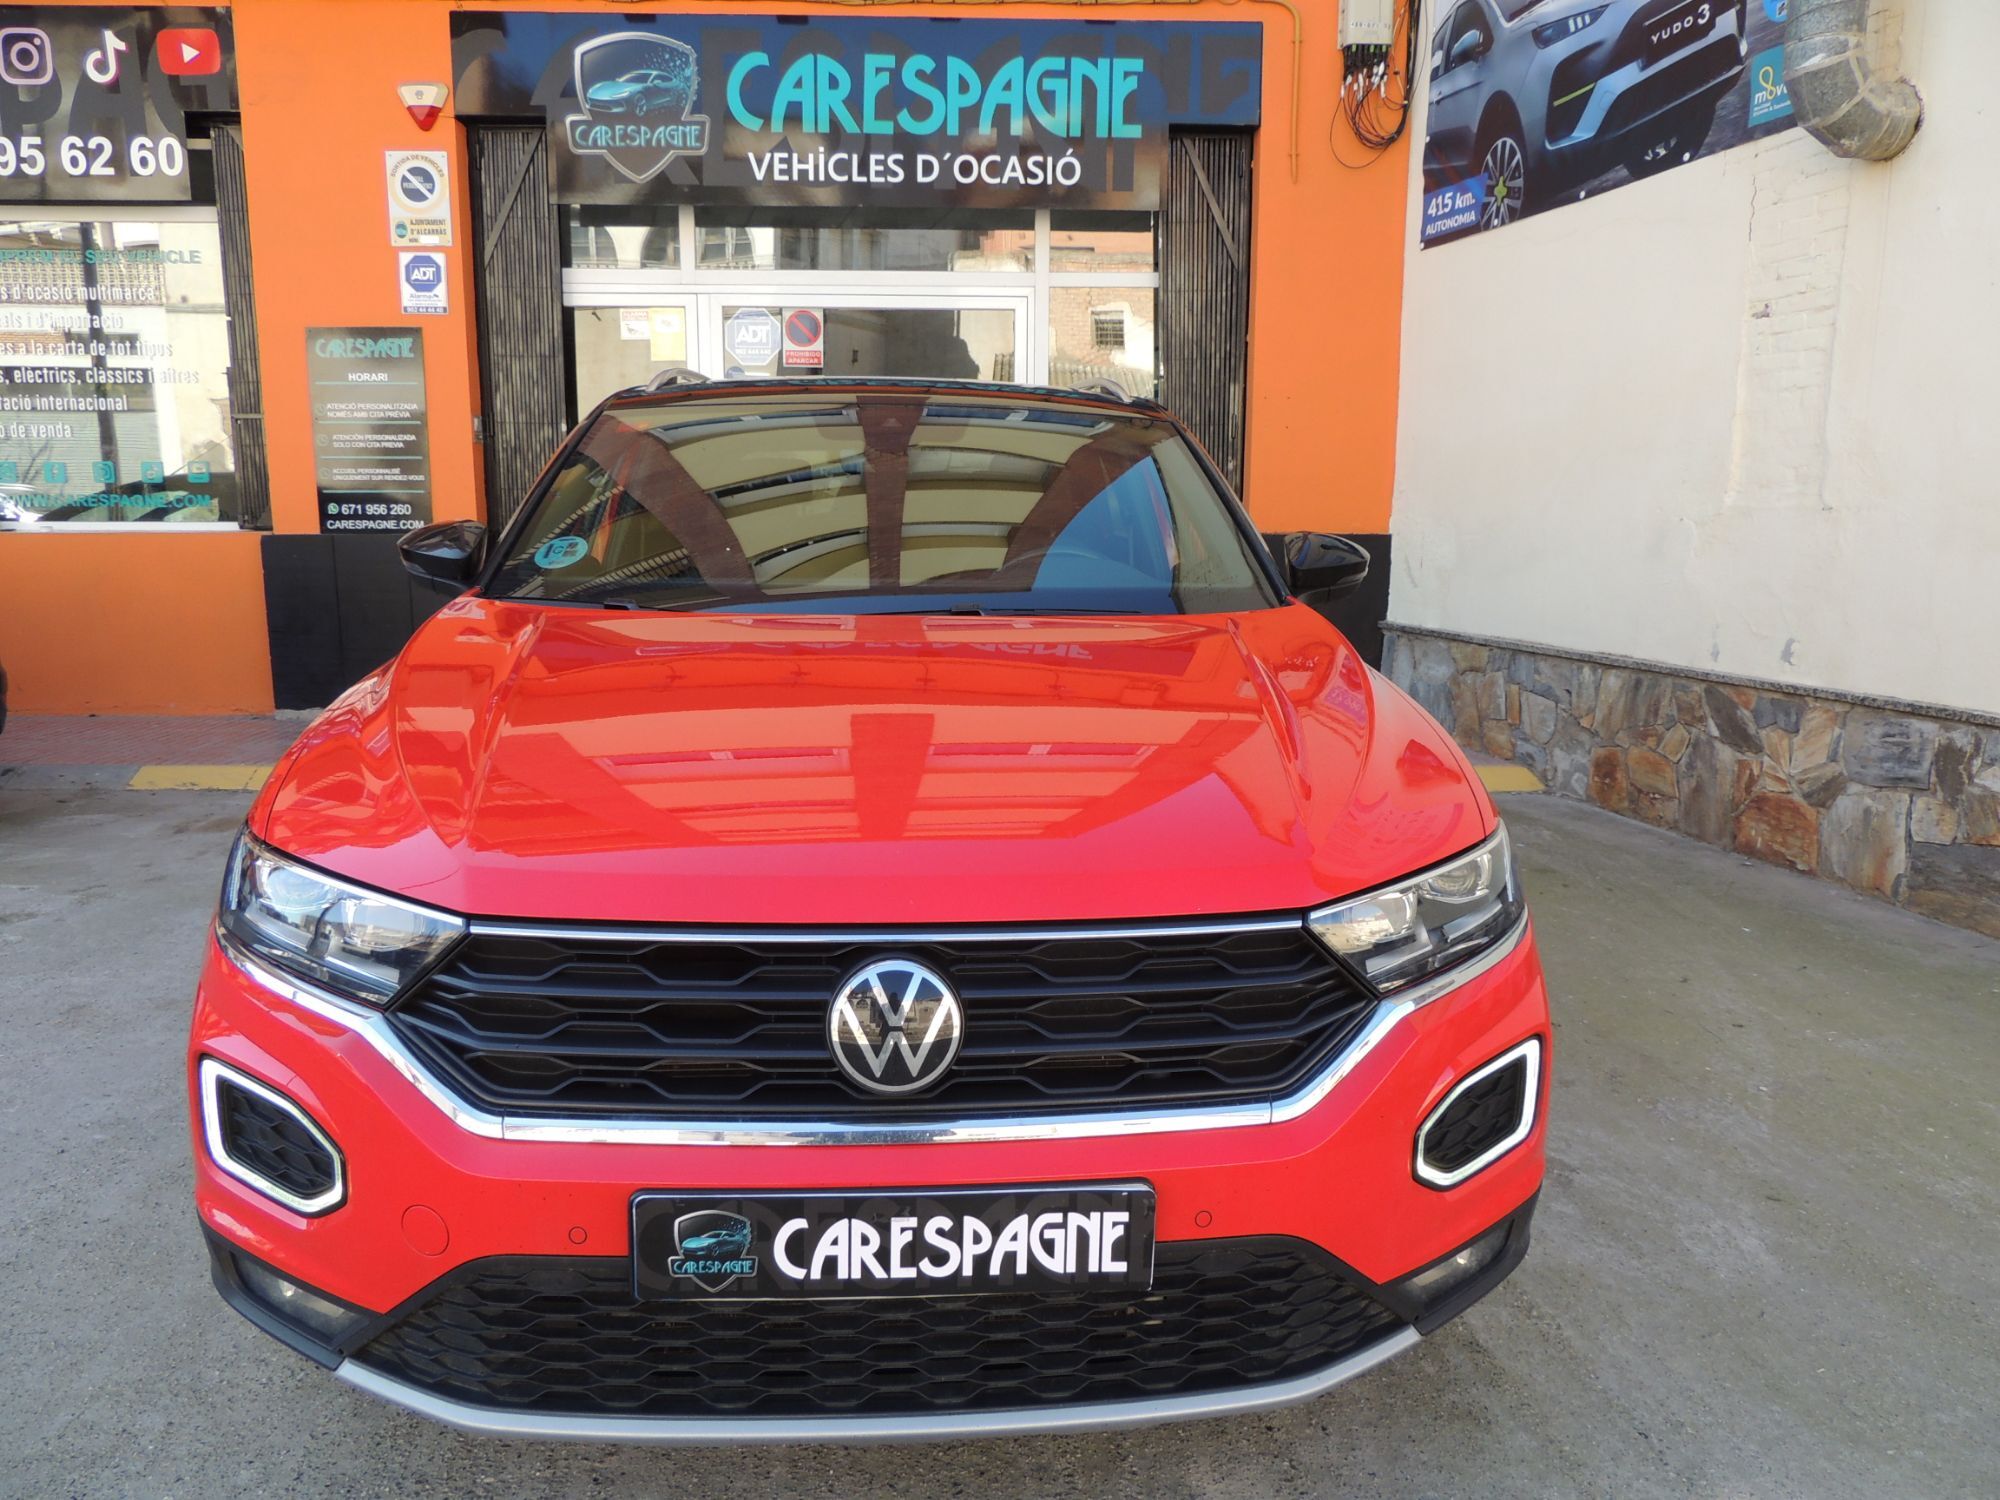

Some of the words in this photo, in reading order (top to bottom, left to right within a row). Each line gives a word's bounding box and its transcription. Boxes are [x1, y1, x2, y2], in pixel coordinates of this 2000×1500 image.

[1651, 16, 1694, 44] YUDO
[1697, 3, 1710, 25] 3
[726, 51, 1144, 138] CARESPAGNE
[575, 124, 702, 147] CARESPAGNE
[60, 136, 116, 176] 62
[130, 136, 184, 176] 60
[1427, 191, 1454, 217] 415
[1454, 191, 1476, 210] km.
[1425, 209, 1476, 236] AUTONOMIA
[126, 249, 202, 265] VEHICLE
[411, 266, 436, 281] ADT
[77, 284, 155, 300] multimarca
[735, 324, 771, 344] ADT
[19, 342, 29, 356] a
[32, 339, 43, 356] la
[48, 340, 85, 357] carta
[90, 339, 106, 356] de
[110, 340, 132, 356] tot
[314, 337, 415, 358] CARESPAGNE
[13, 367, 82, 385] elèctrics,
[85, 367, 143, 384] clàssics
[348, 372, 389, 382] HORARI
[36, 393, 128, 411] internacional
[357, 402, 418, 410] PERSONALITZADA
[369, 410, 385, 418] CITA
[10, 420, 26, 438] de
[31, 420, 72, 438] venda
[364, 433, 416, 441] PERSONALIZADA
[341, 504, 362, 515] 671
[365, 504, 388, 515] 956
[389, 504, 412, 515] 260
[327, 519, 425, 530] CARESPAGNE.COM
[773, 1210, 1130, 1280] CARESPAGNE
[673, 1260, 753, 1274] CARESPAGNE
